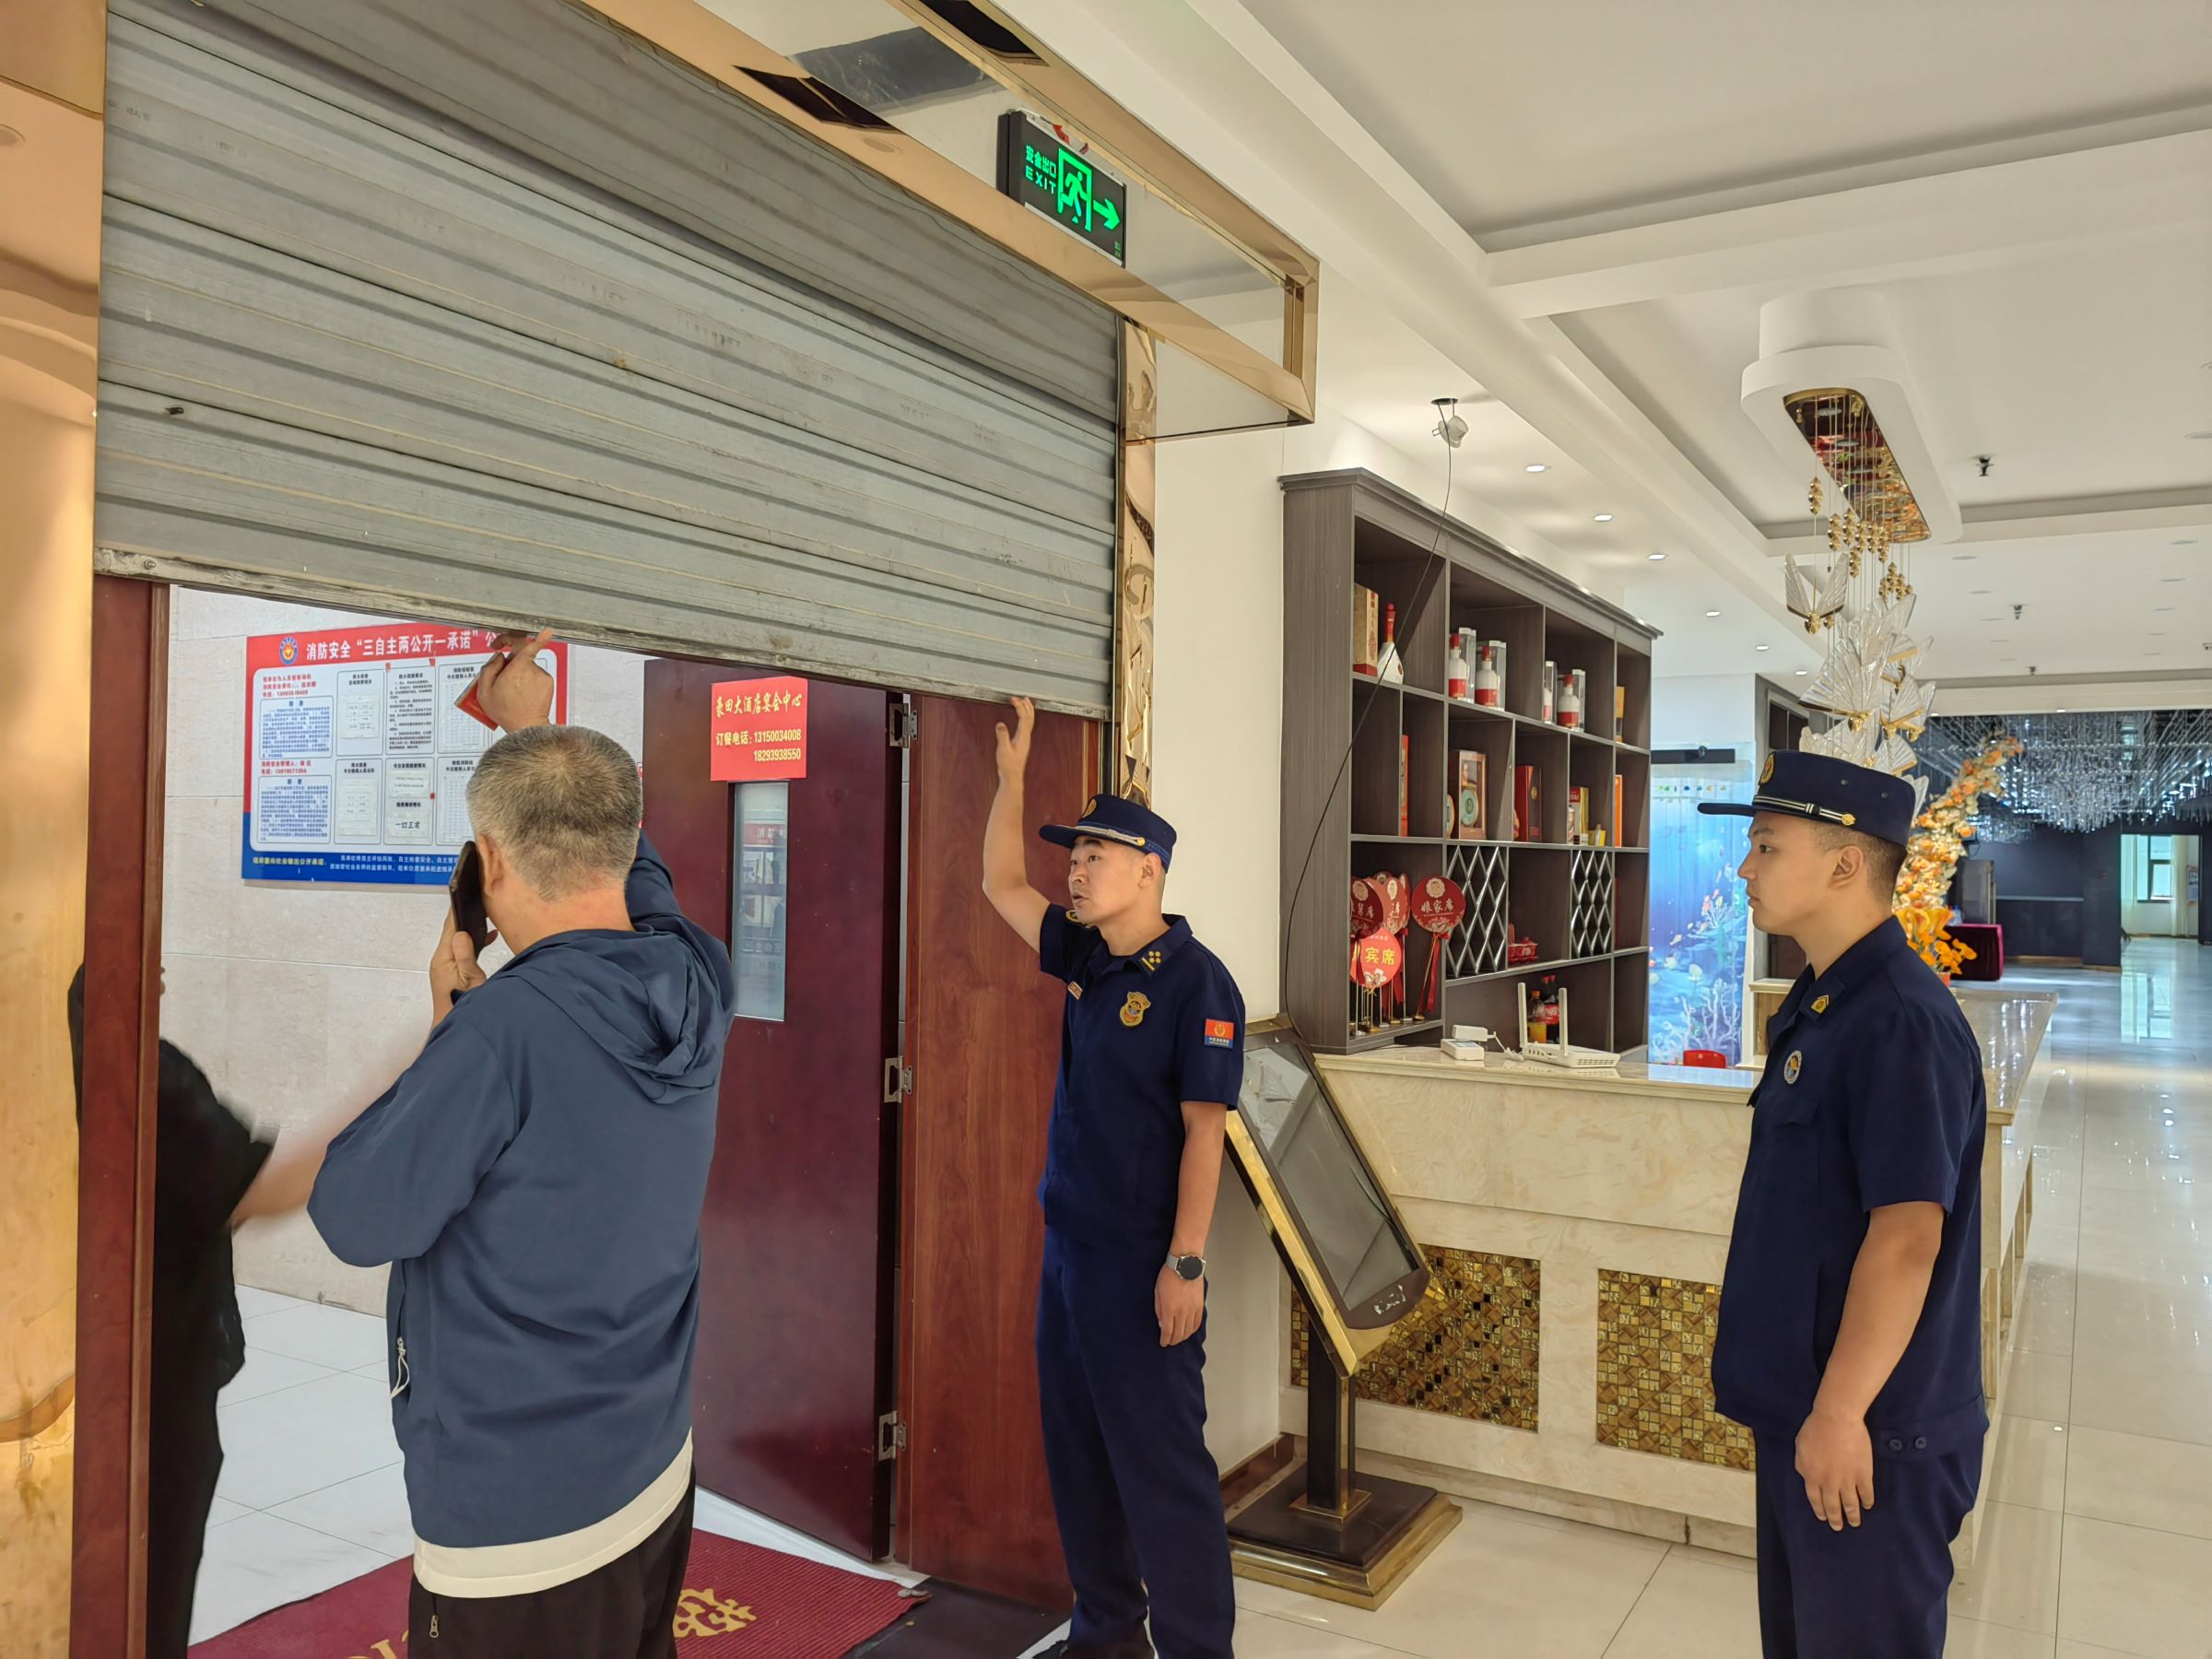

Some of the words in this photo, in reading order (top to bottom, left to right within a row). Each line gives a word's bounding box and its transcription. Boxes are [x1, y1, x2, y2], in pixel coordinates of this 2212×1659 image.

[1026, 145, 1056, 178] 安全出口
[1025, 166, 1056, 194] EXIT
[1420, 899, 1454, 913] 娘家席
